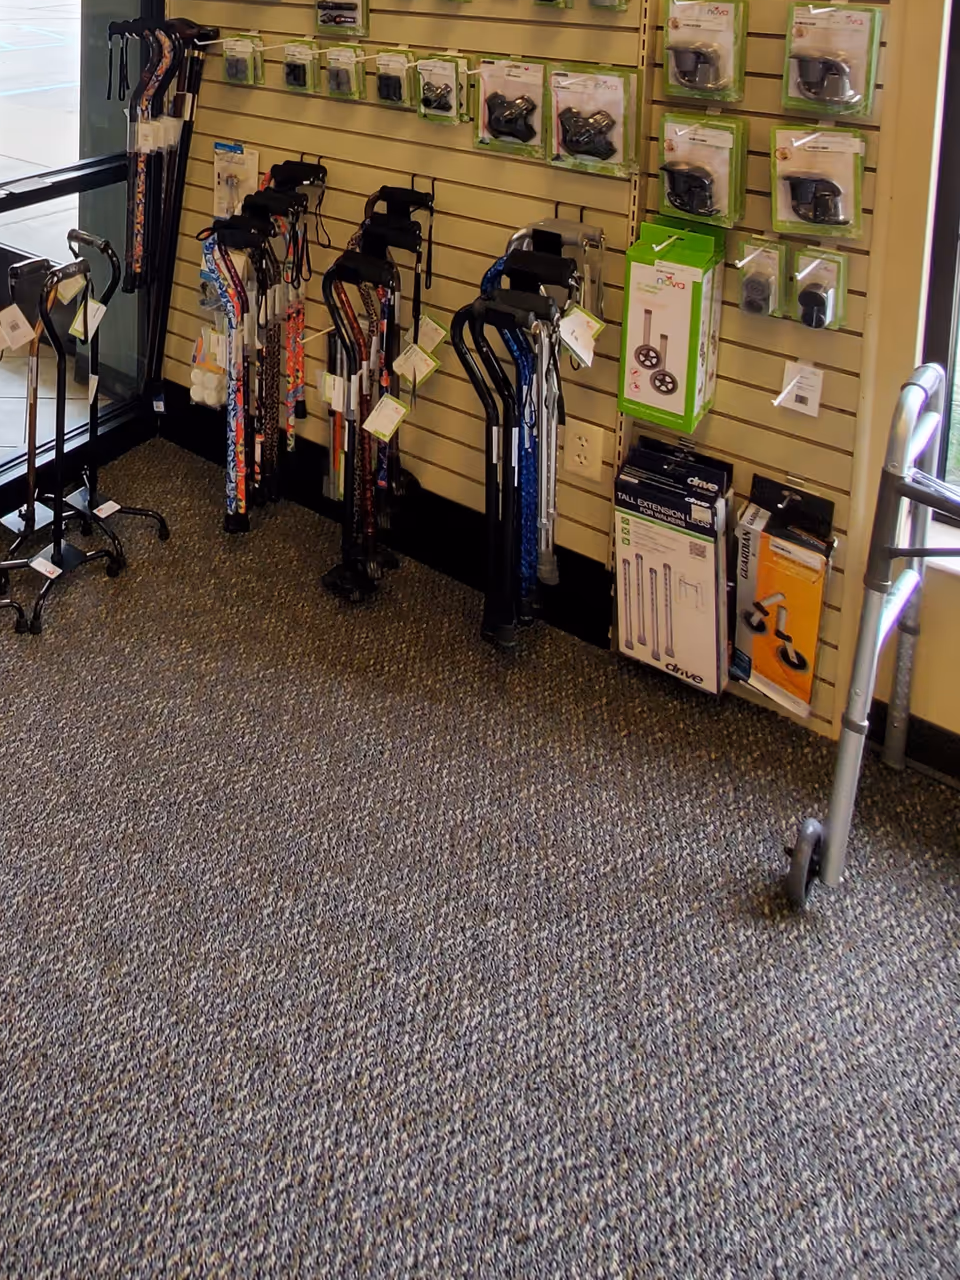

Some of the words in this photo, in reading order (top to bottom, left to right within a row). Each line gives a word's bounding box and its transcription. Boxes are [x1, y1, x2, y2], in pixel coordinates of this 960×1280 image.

[656, 277, 685, 290] nova
[687, 477, 718, 491] drive
[617, 492, 636, 504] TALL
[637, 498, 685, 520] EXTENSION
[640, 507, 654, 516] FOR
[654, 512, 685, 527] WALKERS
[740, 529, 751, 580] GUARDIAN
[665, 663, 704, 685] drive
